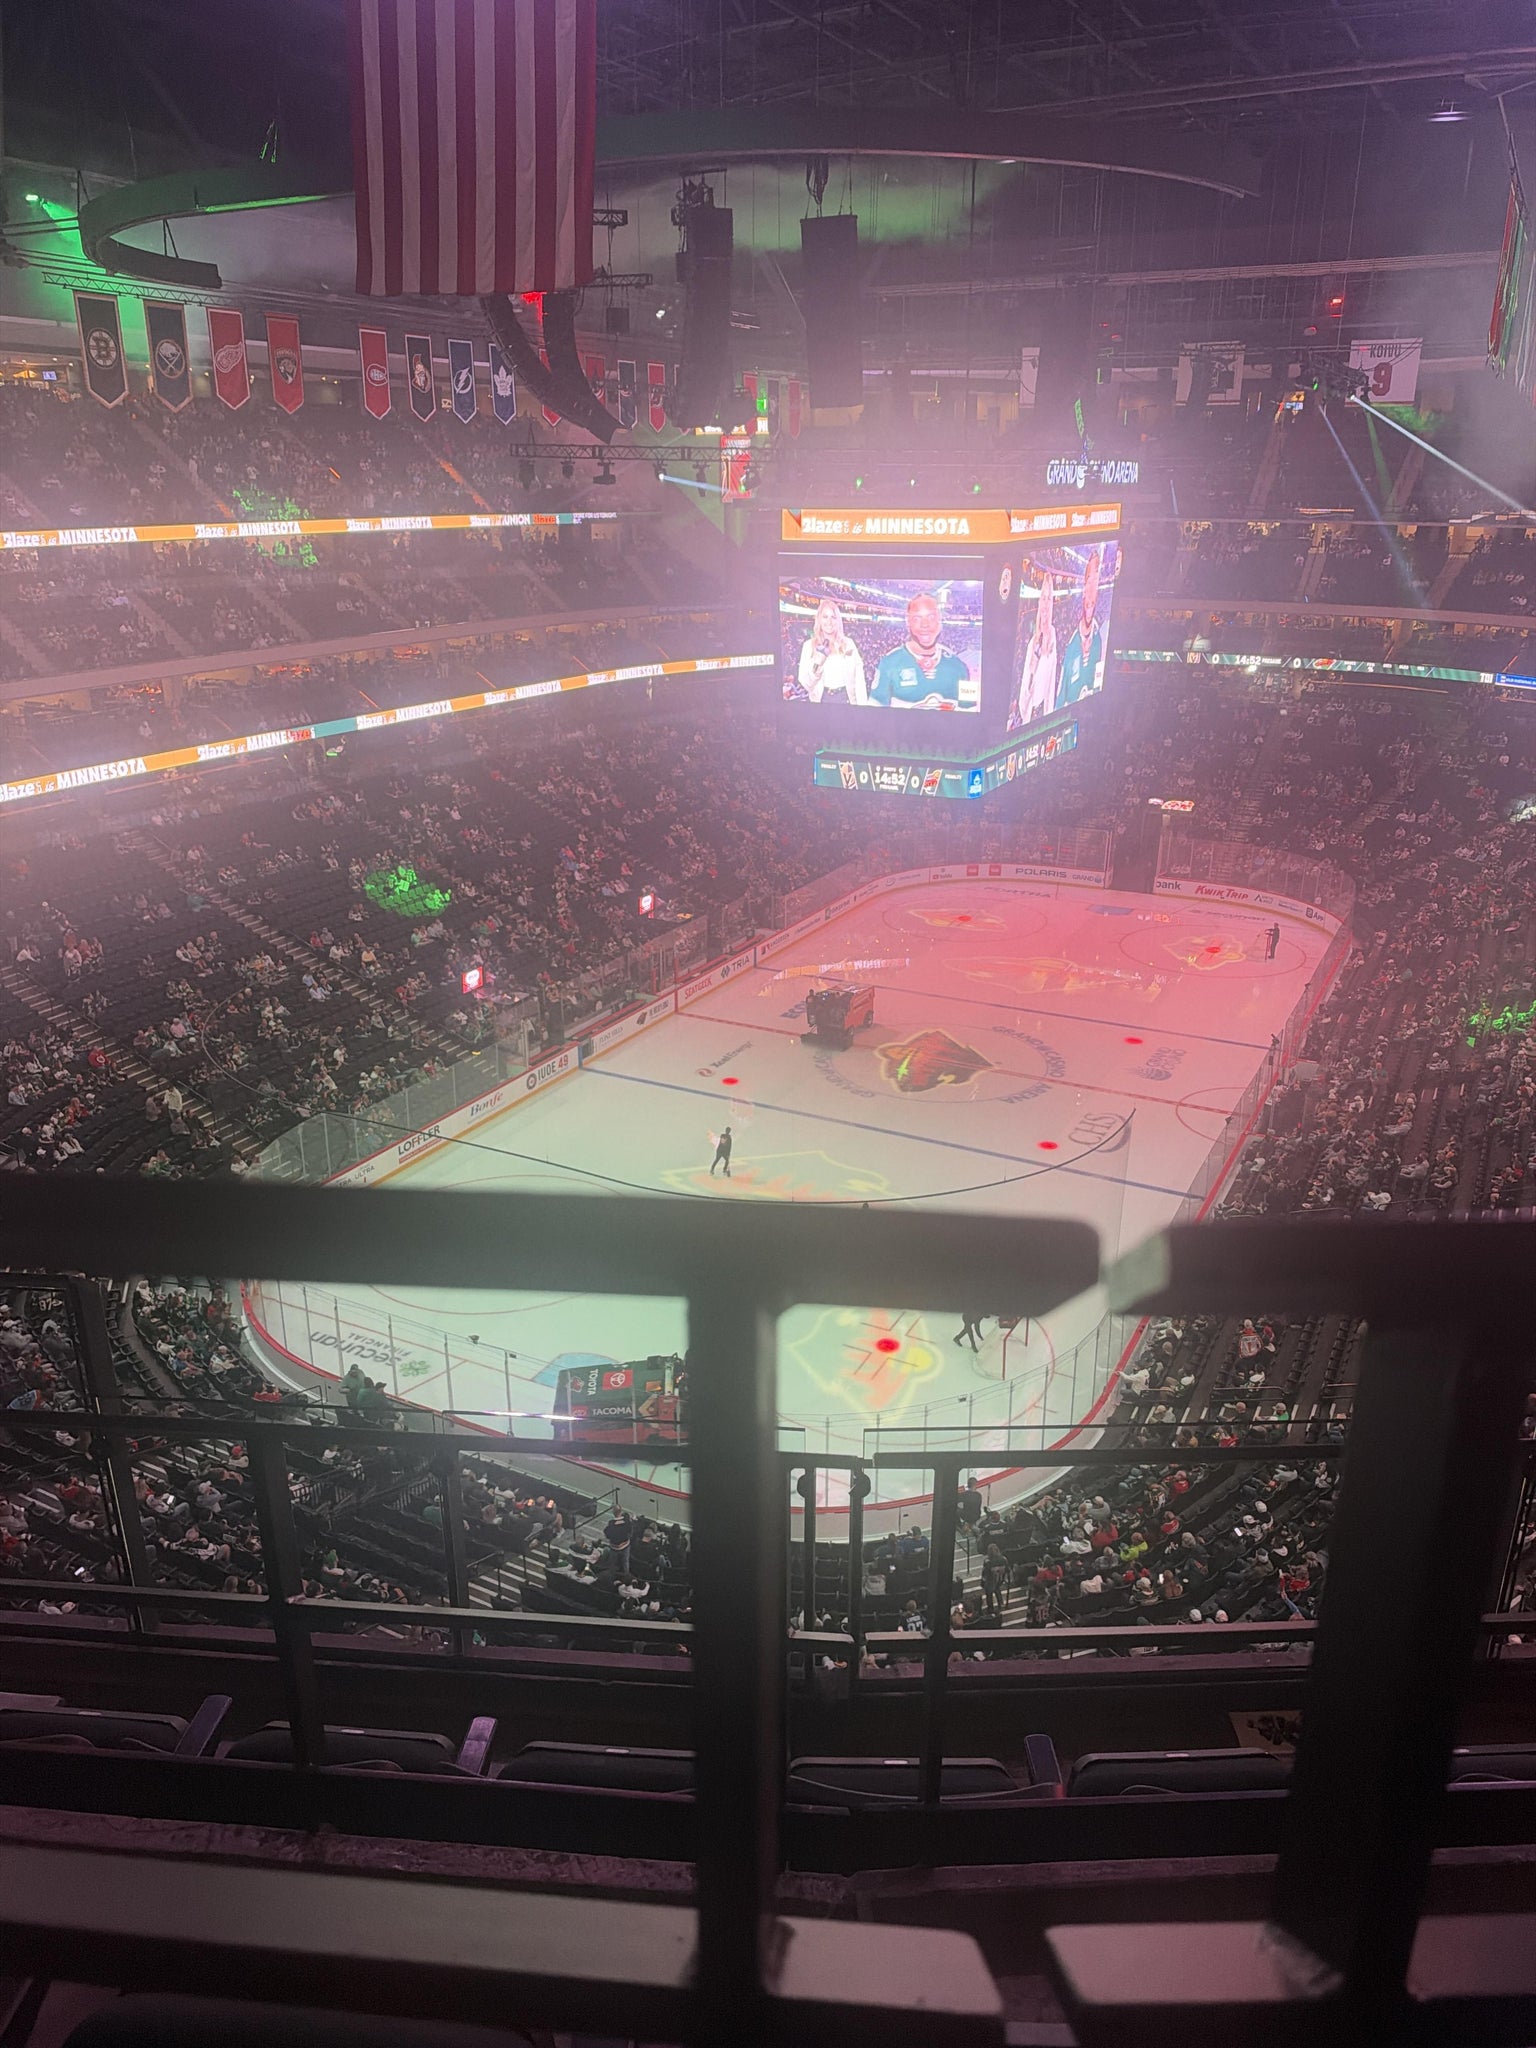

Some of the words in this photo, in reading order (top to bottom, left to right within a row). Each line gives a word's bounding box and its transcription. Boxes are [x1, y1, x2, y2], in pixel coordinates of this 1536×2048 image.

[1372, 362, 1392, 396] 9
[1115, 460, 1139, 484] ARENA
[238, 521, 301, 535] MINNESOTA
[381, 516, 432, 529] MINNESOTA
[865, 517, 970, 536] MINNESOTA
[58, 527, 138, 544] MINNESOTA
[1212, 653, 1220, 665] 0
[1235, 654, 1262, 666] 14:52
[1293, 657, 1302, 669] 0
[396, 700, 452, 723] MINNESOTA
[57, 757, 147, 790] MINNESOTA
[859, 771, 869, 785] 0
[874, 772, 905, 786] 14:52
[910, 775, 920, 789] 0
[1015, 867, 1067, 878] POLARIS
[1072, 873, 1094, 882] GRAND
[732, 955, 750, 973] TRIA
[558, 1054, 569, 1069] 49
[1068, 1112, 1118, 1146] CHS
[398, 1124, 441, 1155] LOFFLER
[354, 1165, 375, 1180] ULTRA
[588, 1368, 599, 1396] TOYOTA
[592, 1406, 633, 1416] TACOMA
